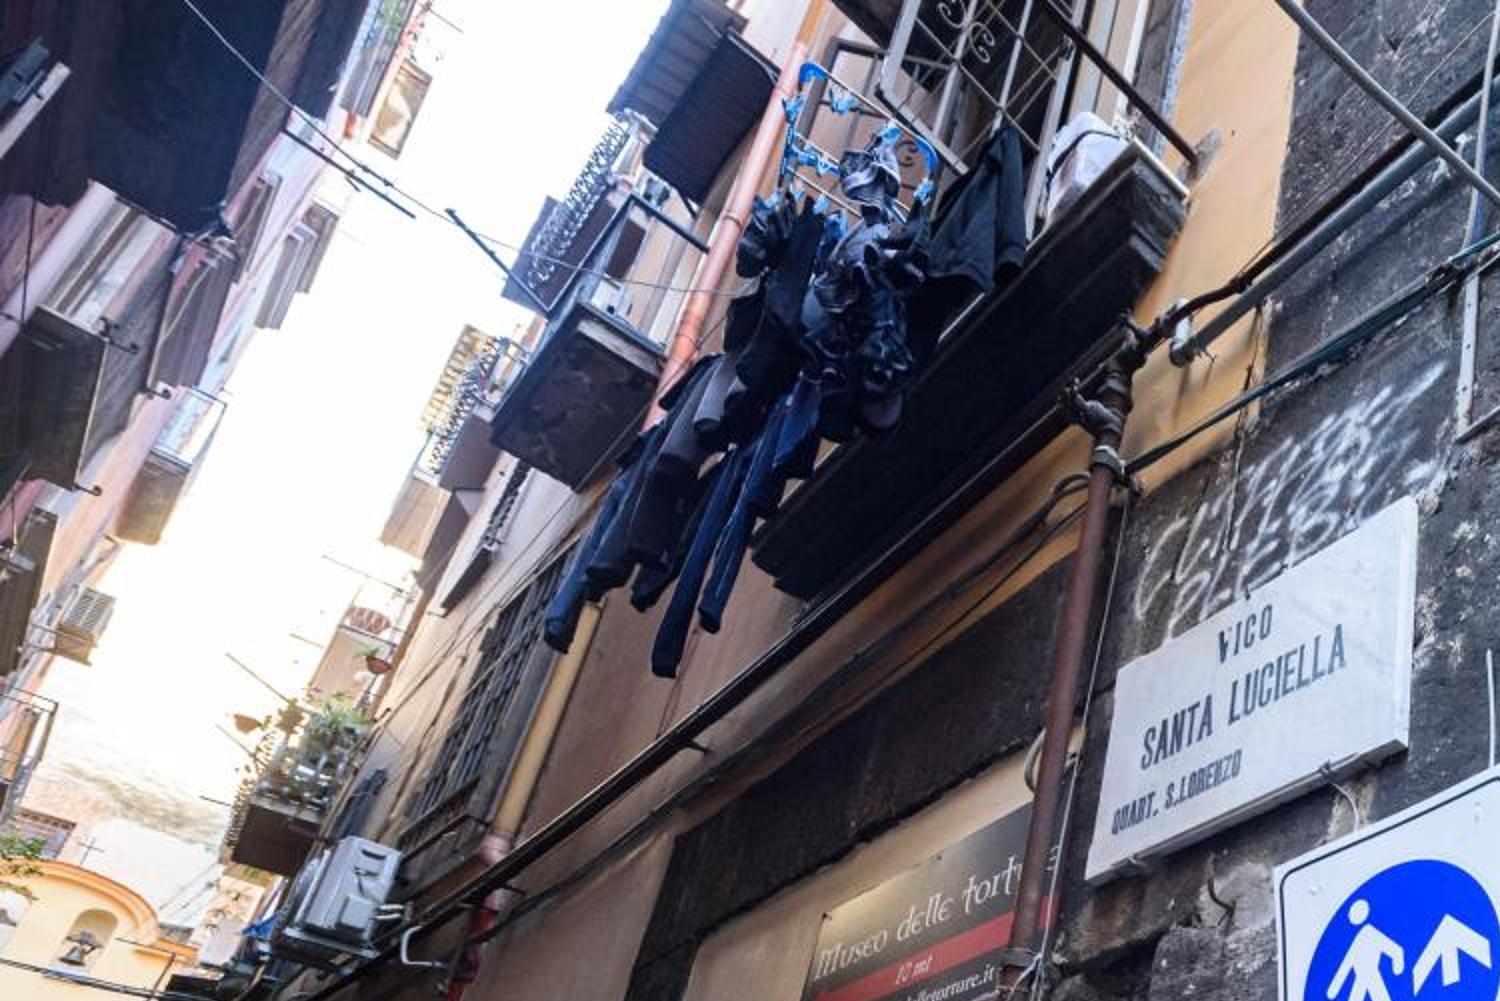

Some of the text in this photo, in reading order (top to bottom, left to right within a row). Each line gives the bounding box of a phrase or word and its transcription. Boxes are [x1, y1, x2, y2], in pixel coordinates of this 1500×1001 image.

[1219, 604, 1273, 664] VICO
[1141, 623, 1346, 770] SANTA LUCIELLA
[1111, 791, 1158, 835] QUART.
[814, 929, 888, 982] Museo
[896, 891, 955, 942] delle
